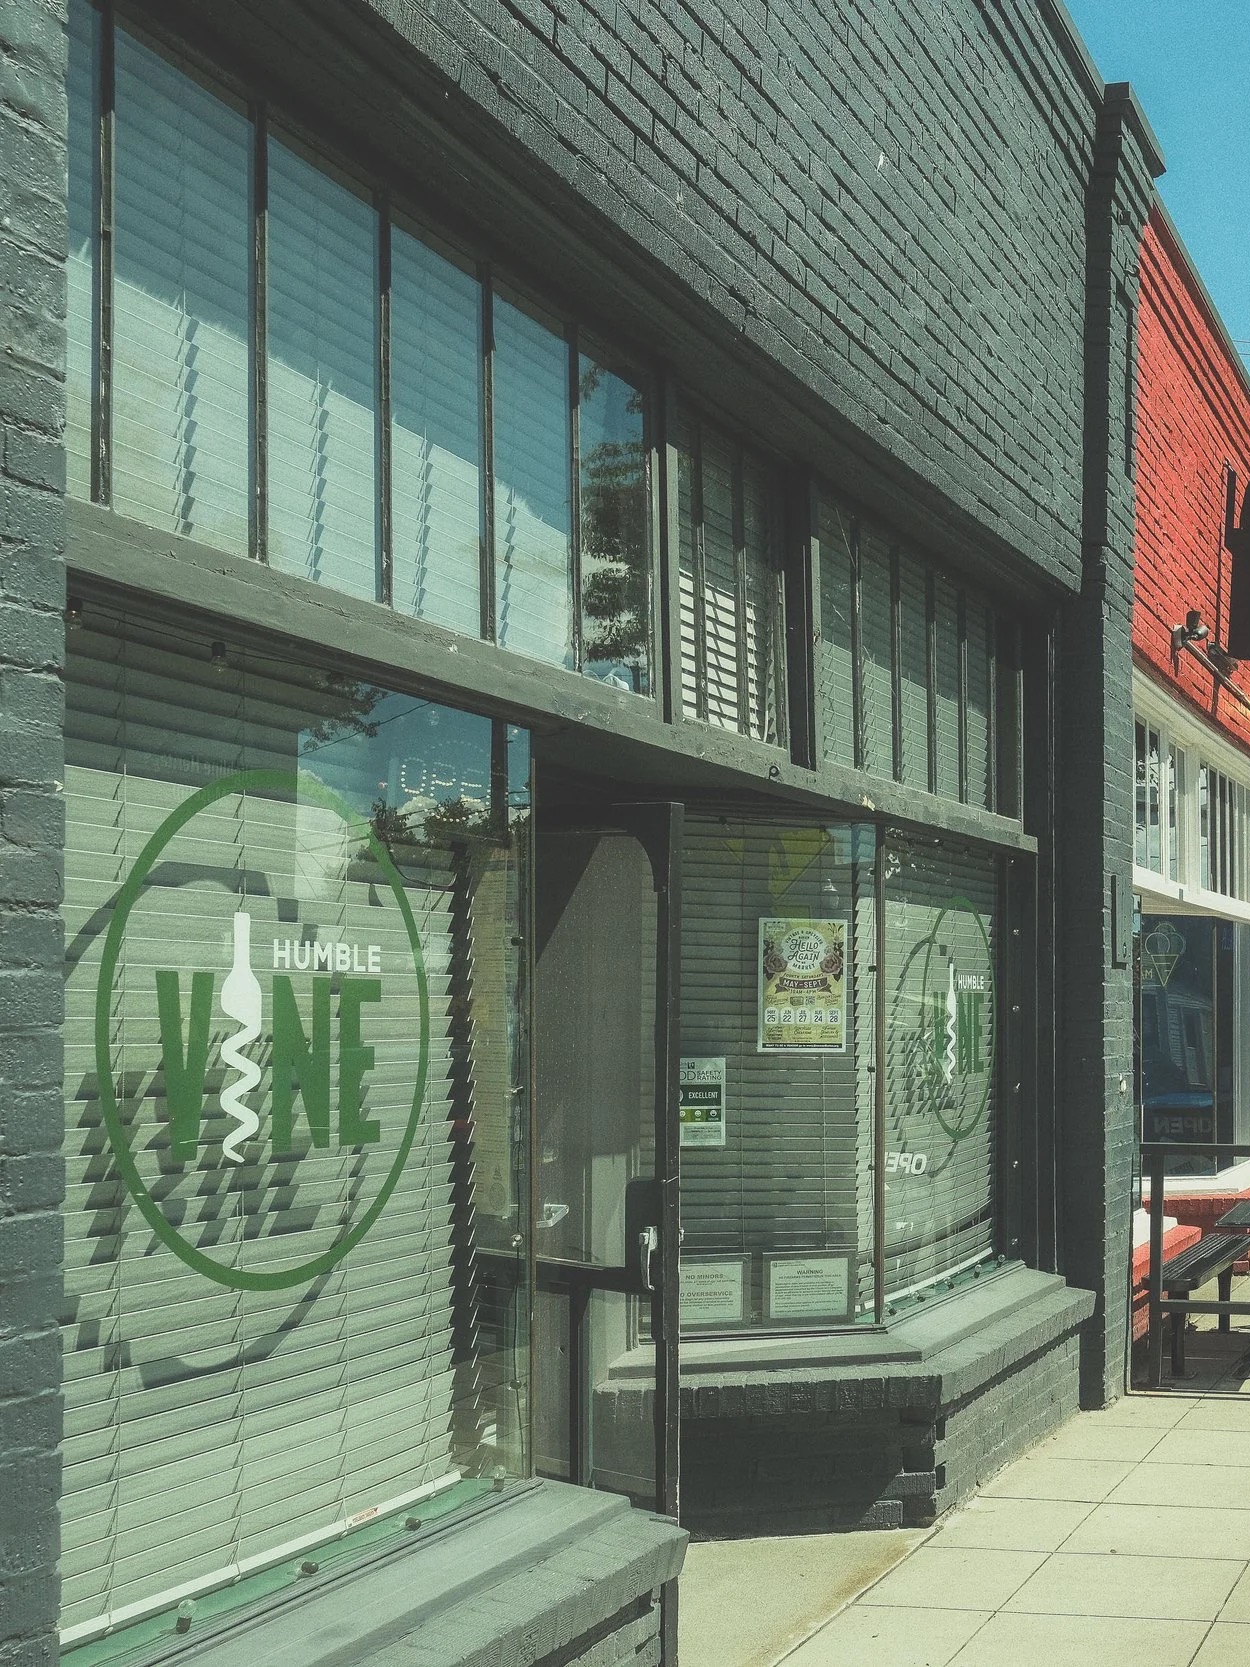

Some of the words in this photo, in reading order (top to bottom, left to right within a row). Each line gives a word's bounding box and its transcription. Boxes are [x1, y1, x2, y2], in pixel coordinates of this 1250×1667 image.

[273, 938, 381, 973] HUMBLE
[783, 979, 822, 989] MAY-SEPT
[957, 974, 985, 990] HUMBLE
[766, 1014, 776, 1023] 25
[783, 1014, 792, 1023] 22
[799, 1014, 807, 1023] 27
[814, 1015, 823, 1023] 24
[829, 1015, 839, 1023] 28
[680, 1071, 696, 1081] OD
[688, 1091, 719, 1099] EXCELLENT
